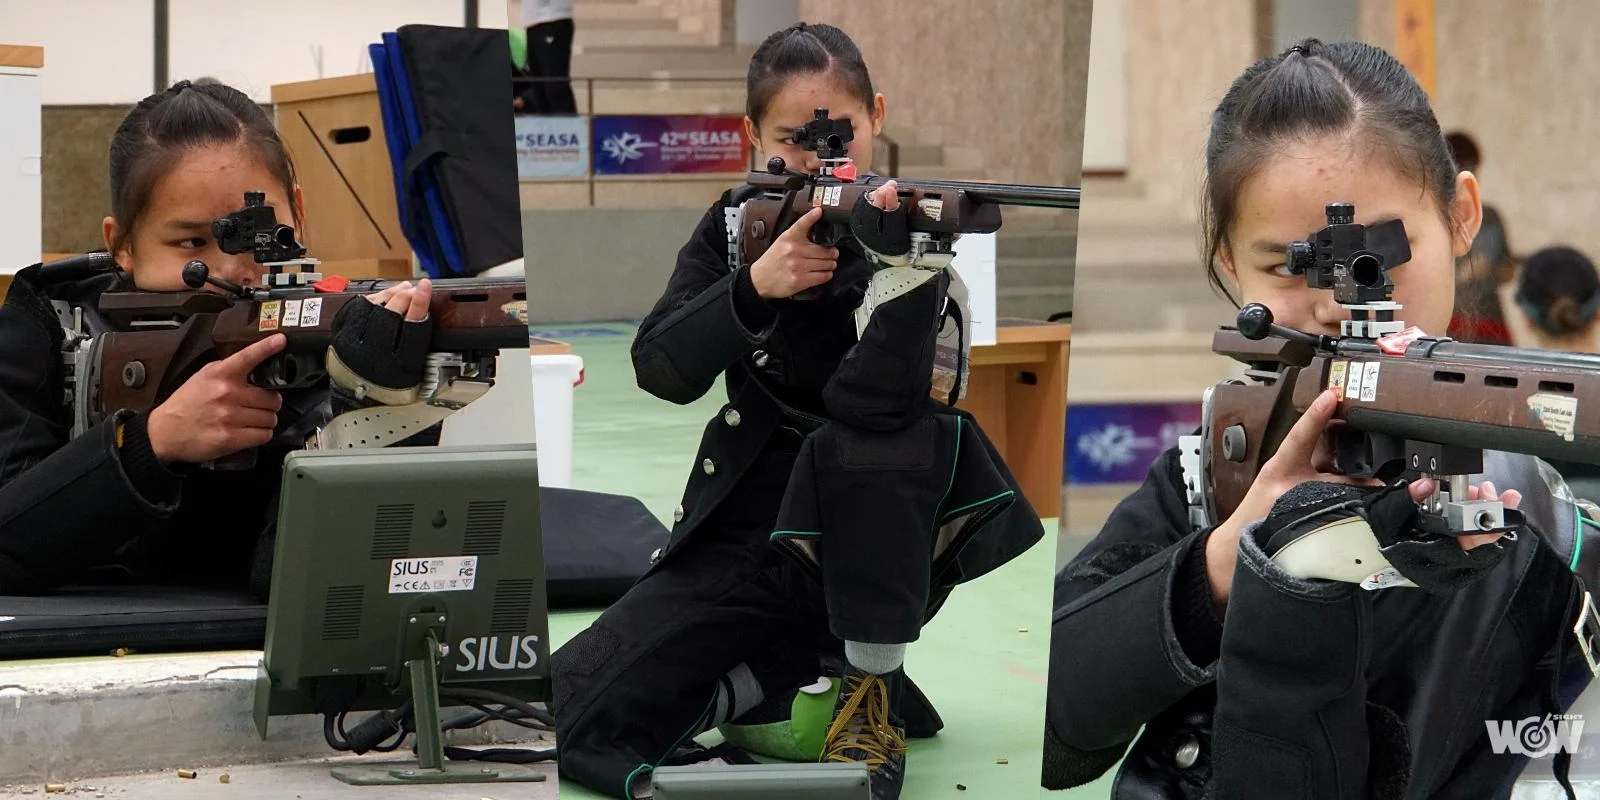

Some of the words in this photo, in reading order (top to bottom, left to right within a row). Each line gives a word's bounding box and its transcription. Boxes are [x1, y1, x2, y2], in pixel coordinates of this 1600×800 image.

[526, 132, 579, 146] SEASA
[689, 131, 741, 146] SEASA
[393, 561, 429, 576] SIUS
[456, 635, 539, 671] SIUS
